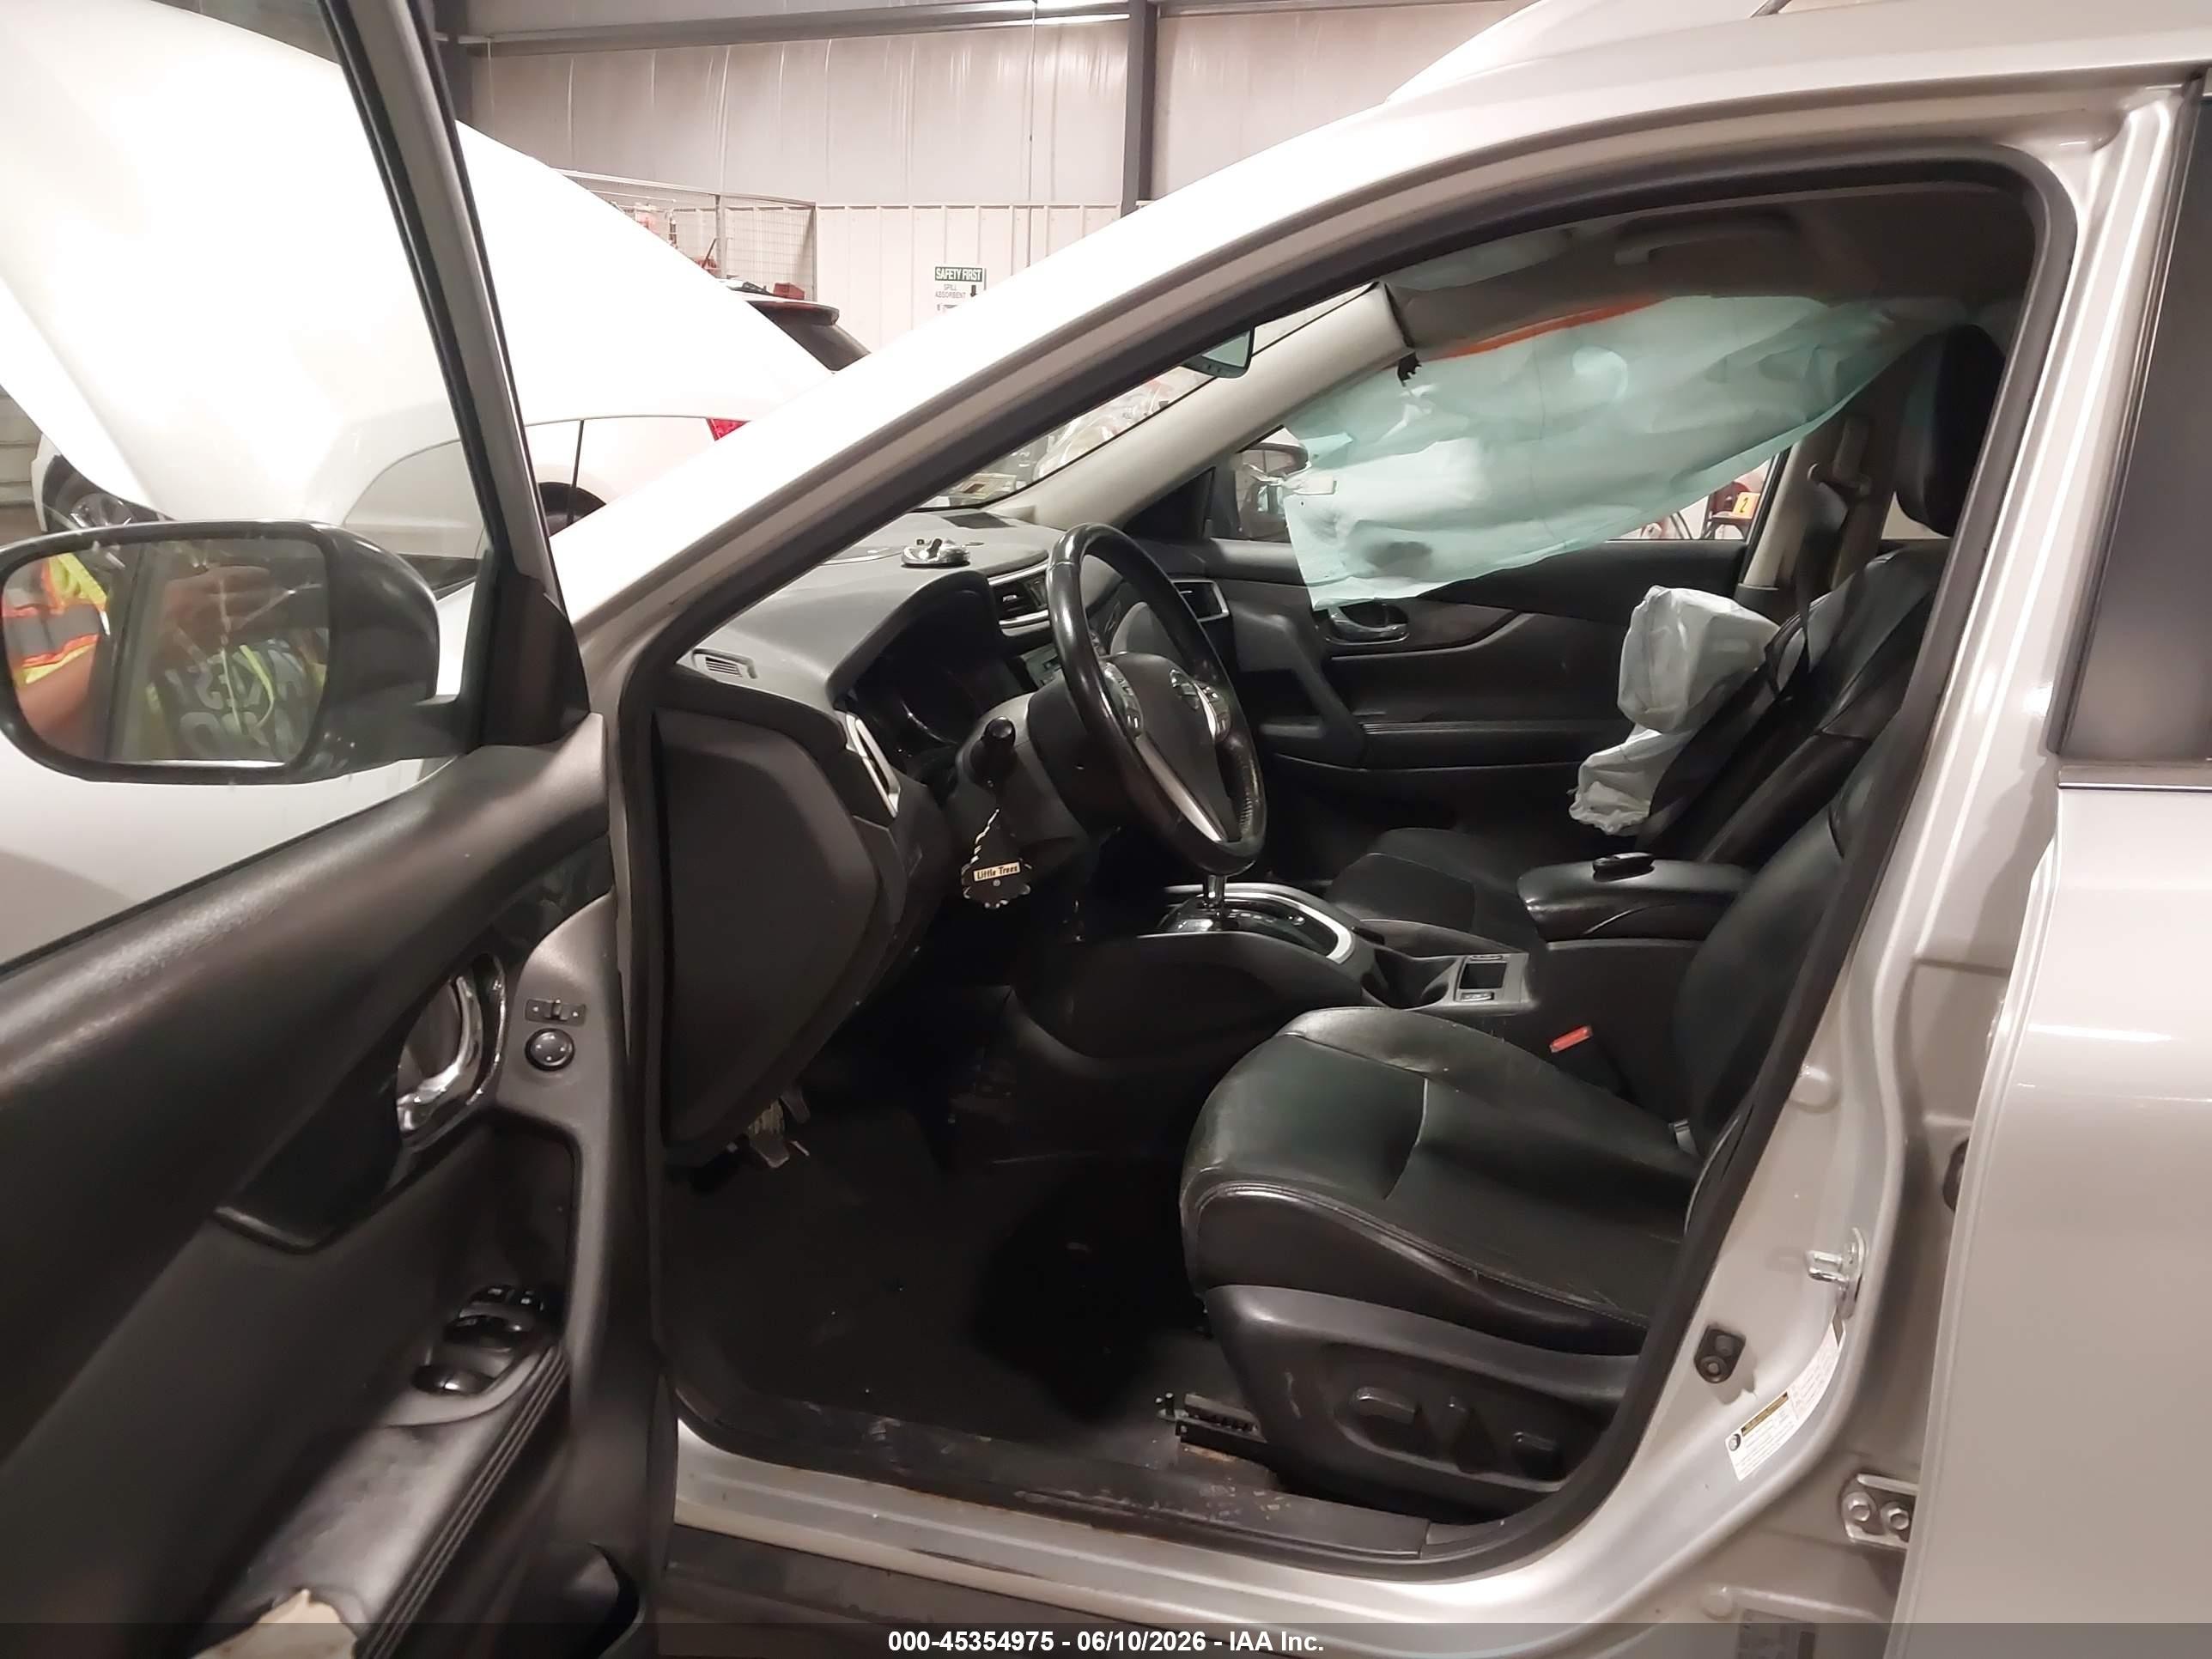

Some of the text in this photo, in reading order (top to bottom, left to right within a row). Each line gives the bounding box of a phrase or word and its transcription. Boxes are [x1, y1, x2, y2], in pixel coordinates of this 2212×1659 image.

[936, 267, 981, 282] SAFETY FIRST
[1739, 496, 1749, 514] 2
[976, 866, 1018, 879] Little Trees
